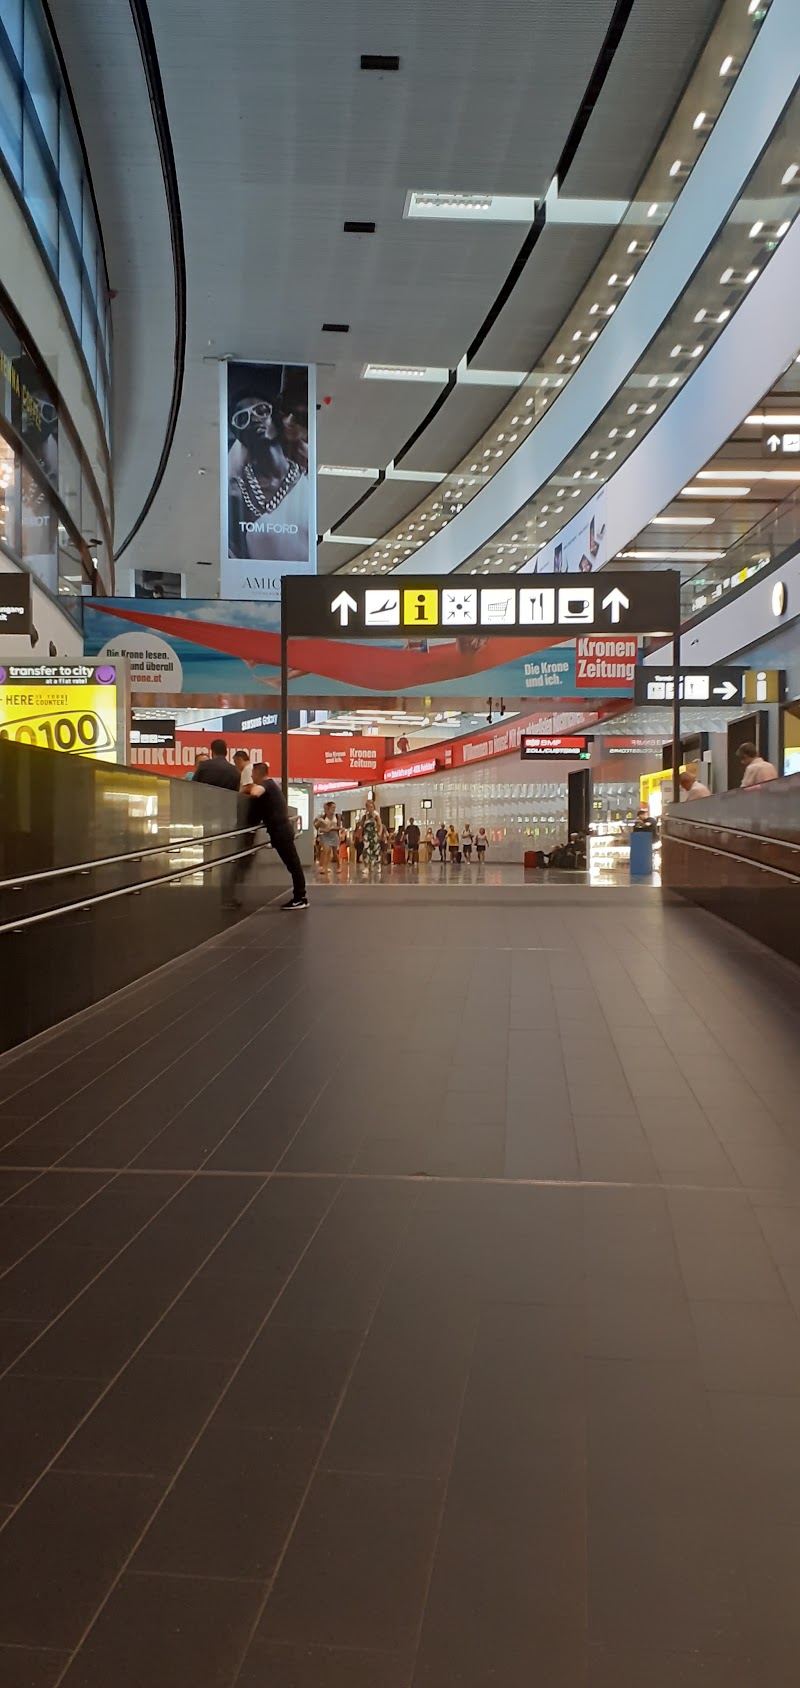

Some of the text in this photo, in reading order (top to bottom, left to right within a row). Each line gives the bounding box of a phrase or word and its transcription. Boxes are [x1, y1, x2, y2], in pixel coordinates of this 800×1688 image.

[239, 522, 298, 534] TOM FORD
[578, 637, 636, 657] Kronen
[106, 649, 170, 660] Die Krone lesen.
[9, 666, 95, 678] transfer to city
[146, 662, 174, 671] überall
[524, 661, 569, 676] Die Krone
[577, 659, 636, 681] Zeitung
[525, 674, 563, 689] und ich.
[5, 694, 34, 705] HERE
[540, 739, 562, 747] BMF
[349, 747, 377, 759] Kronen
[349, 758, 377, 770] Zeitung
